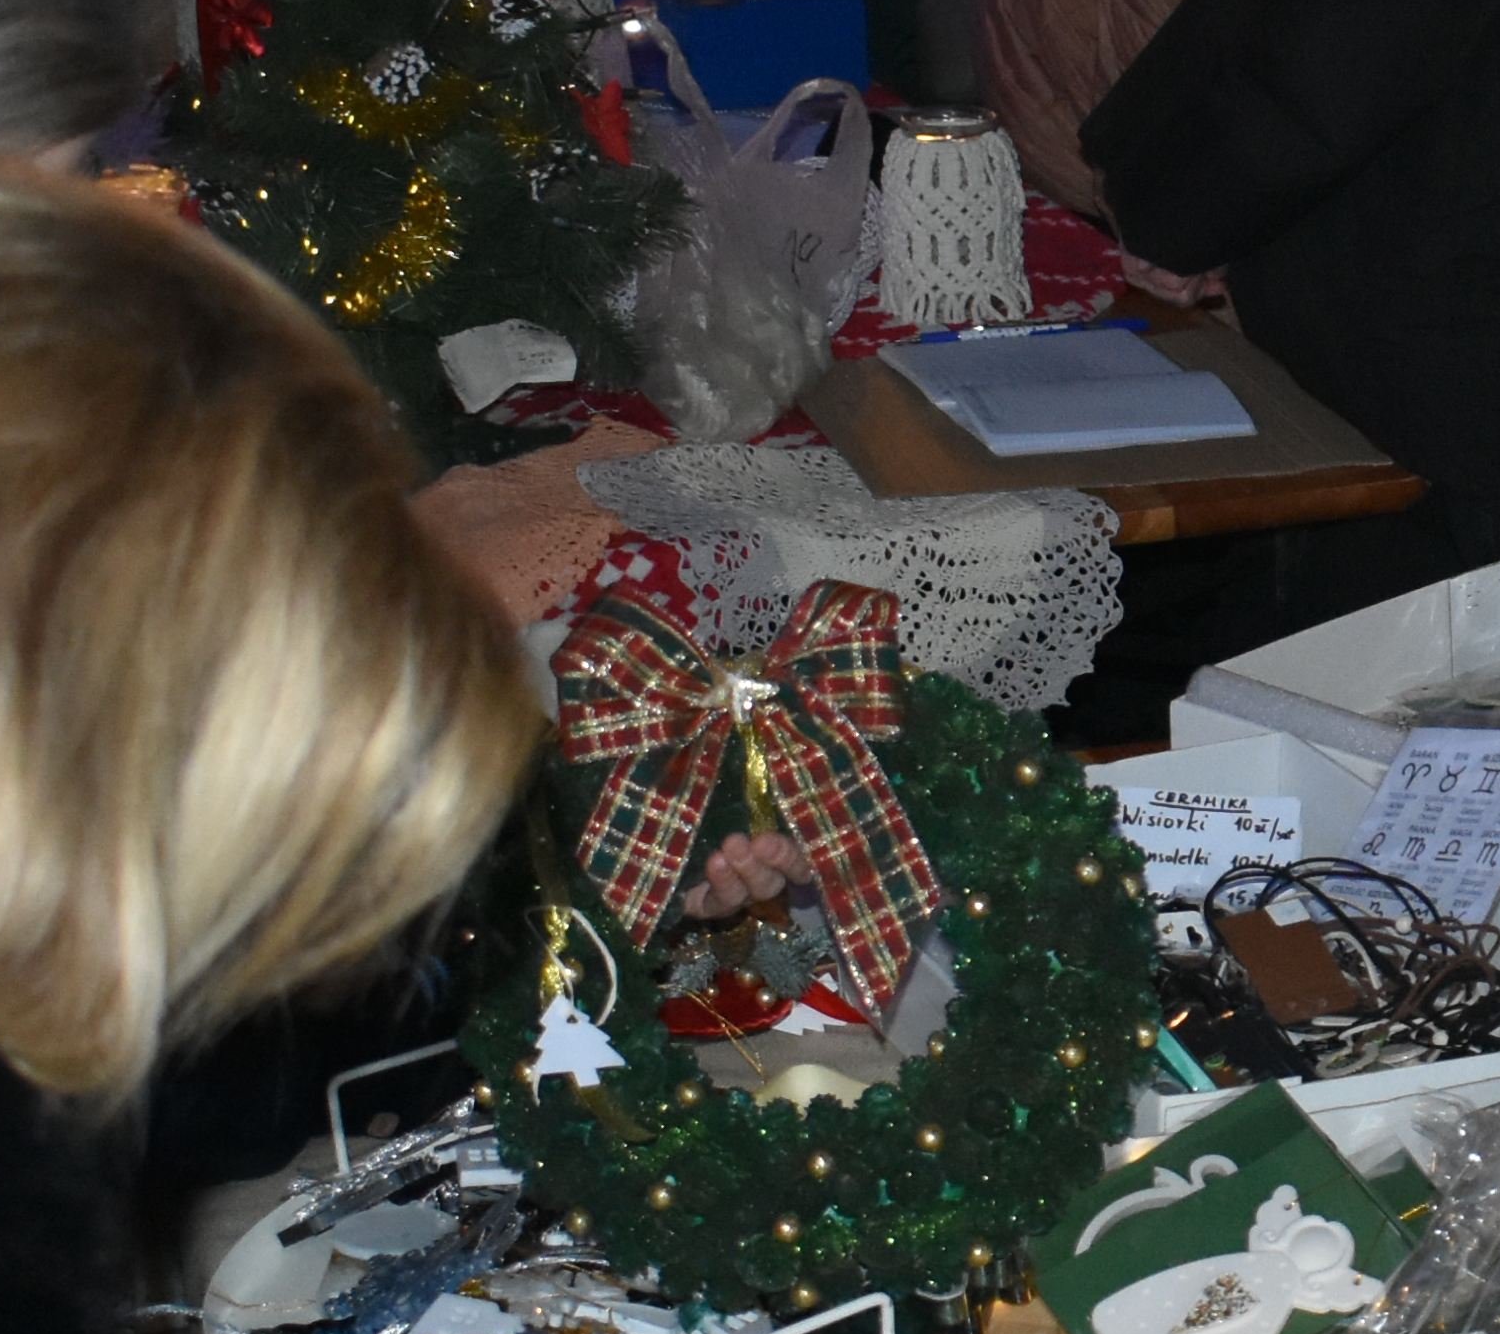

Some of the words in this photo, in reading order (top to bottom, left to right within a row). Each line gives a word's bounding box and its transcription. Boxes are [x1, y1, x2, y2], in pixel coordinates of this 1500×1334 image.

[1153, 790, 1250, 810] CERAMIKA
[1121, 804, 1210, 833] Wisiorki
[1145, 847, 1212, 867] nsoletki
